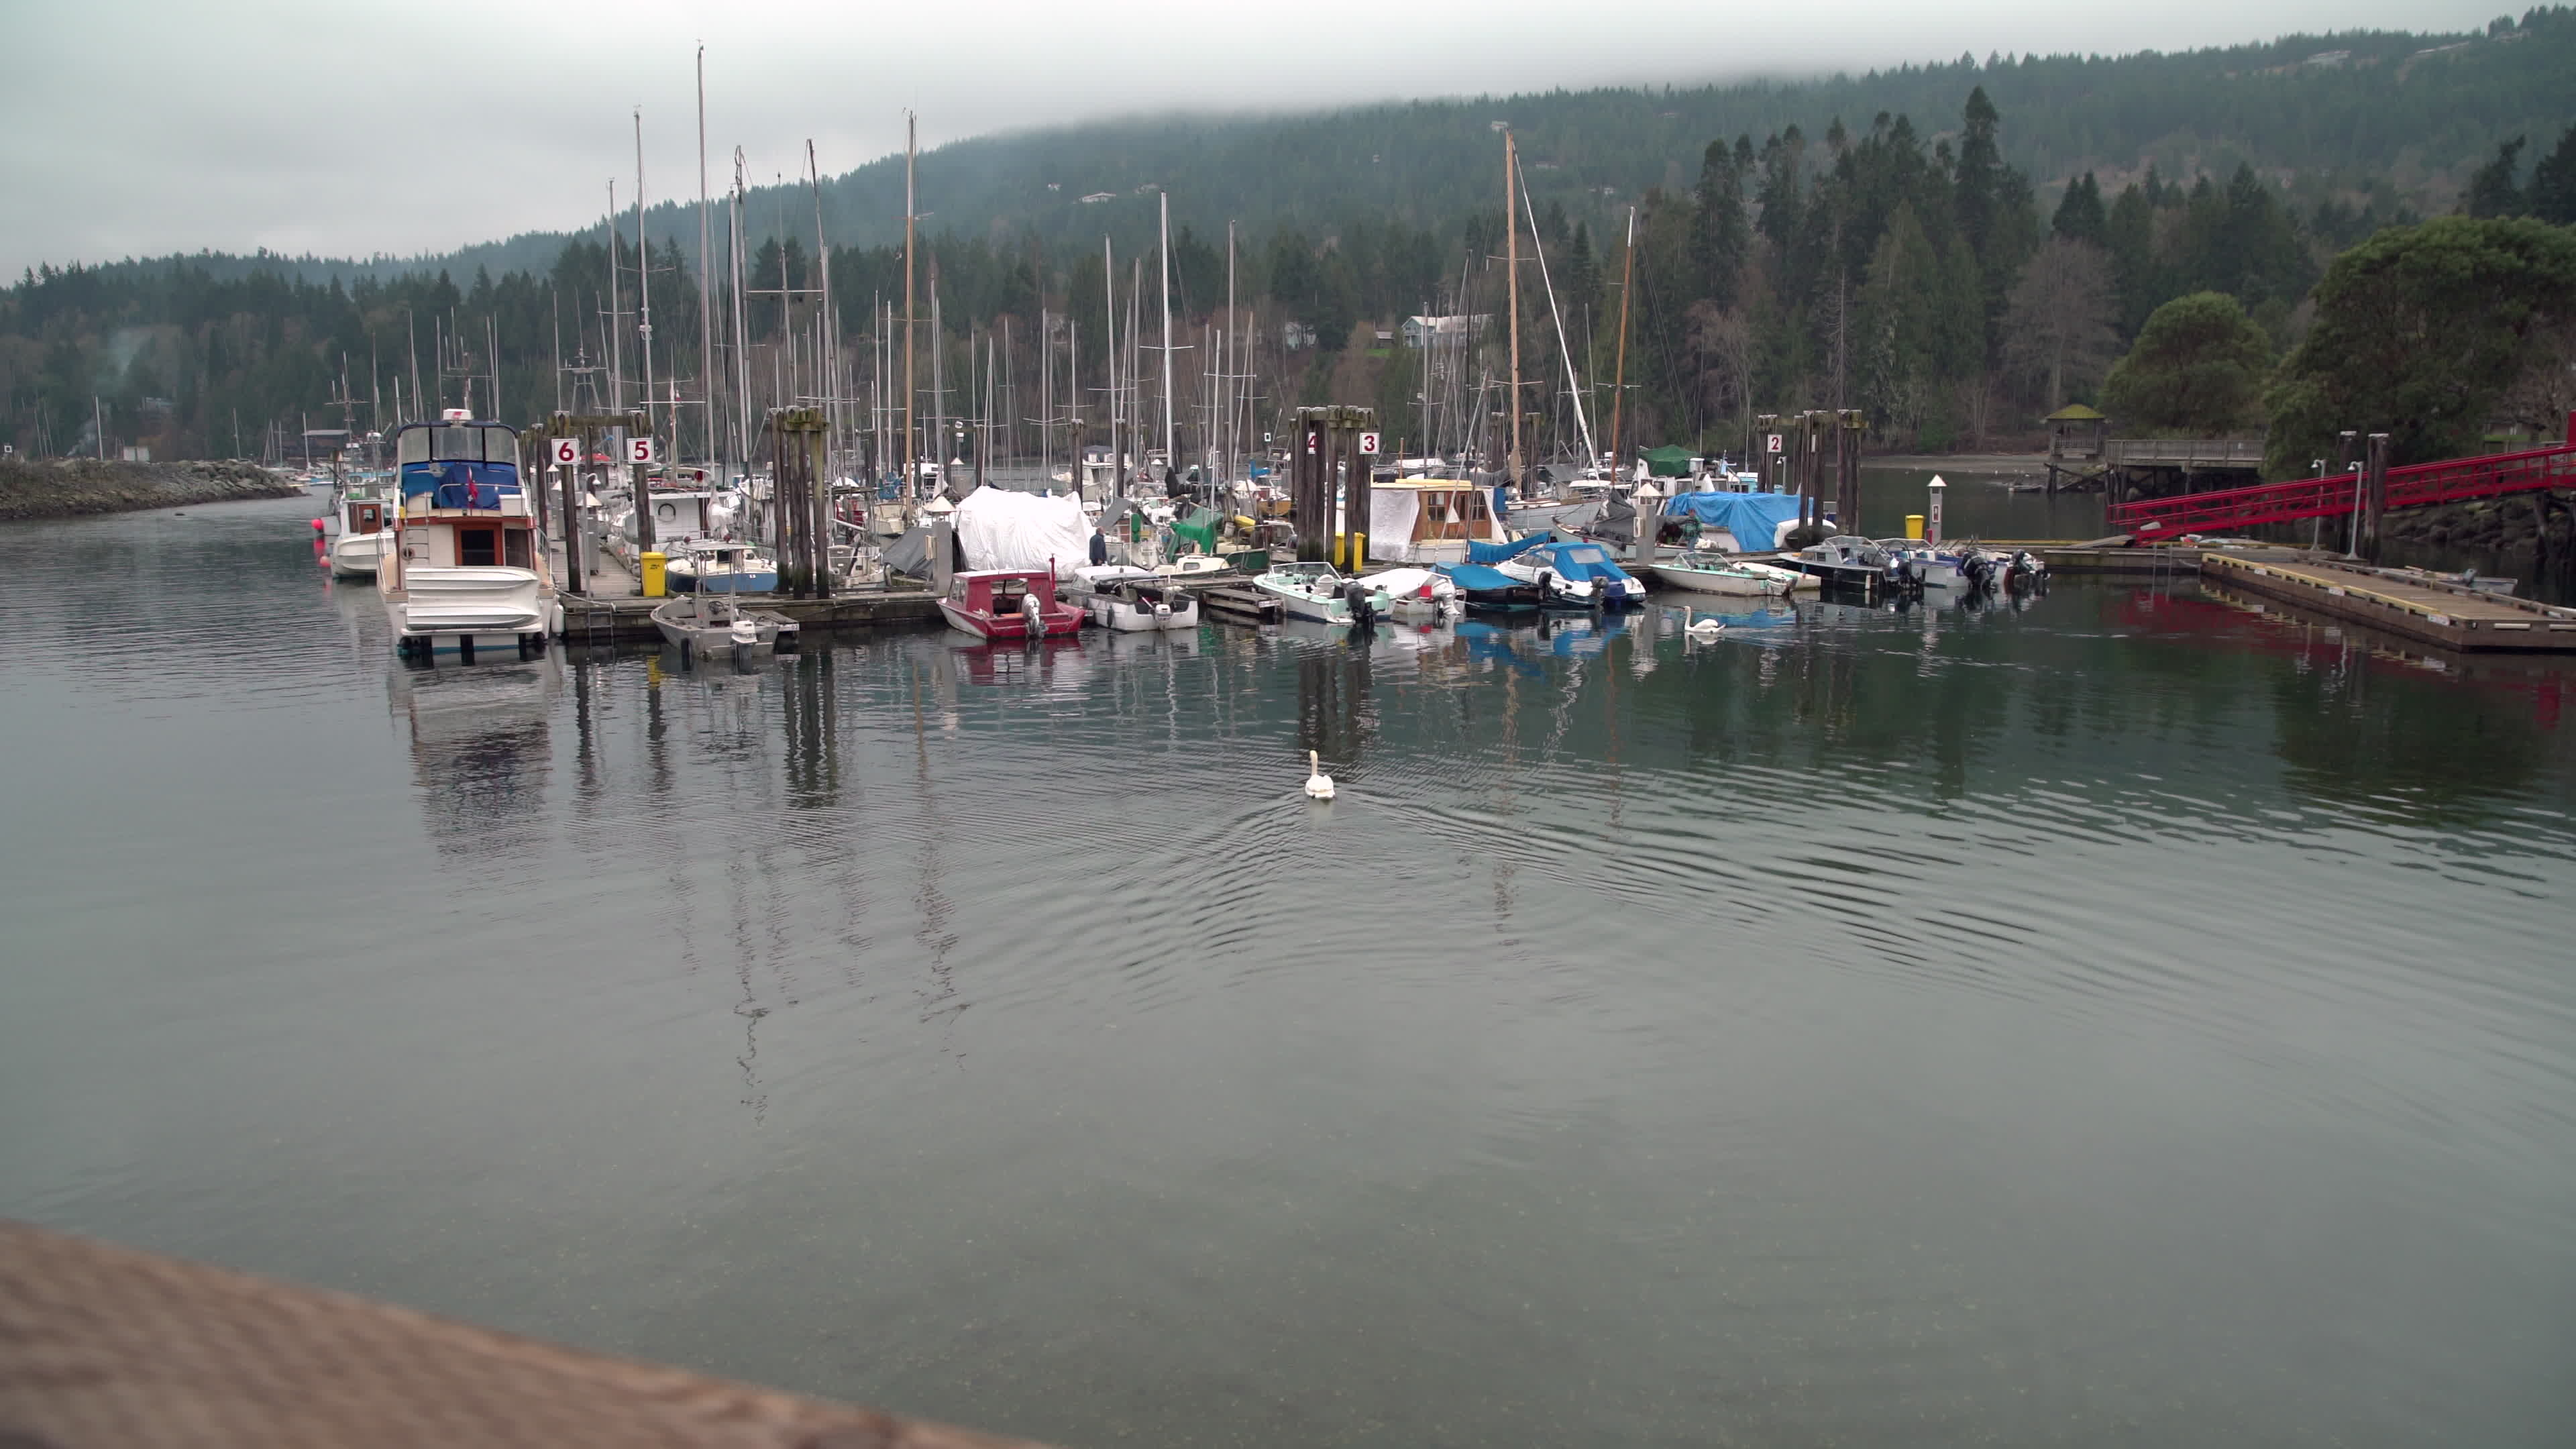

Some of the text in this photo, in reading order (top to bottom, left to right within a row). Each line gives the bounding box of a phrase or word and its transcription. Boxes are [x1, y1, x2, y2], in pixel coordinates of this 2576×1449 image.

[635, 441, 649, 460] 5
[1308, 435, 1316, 451] 4
[1364, 435, 1375, 451] 3
[1771, 437, 1779, 450] 2
[559, 442, 574, 462] 6
